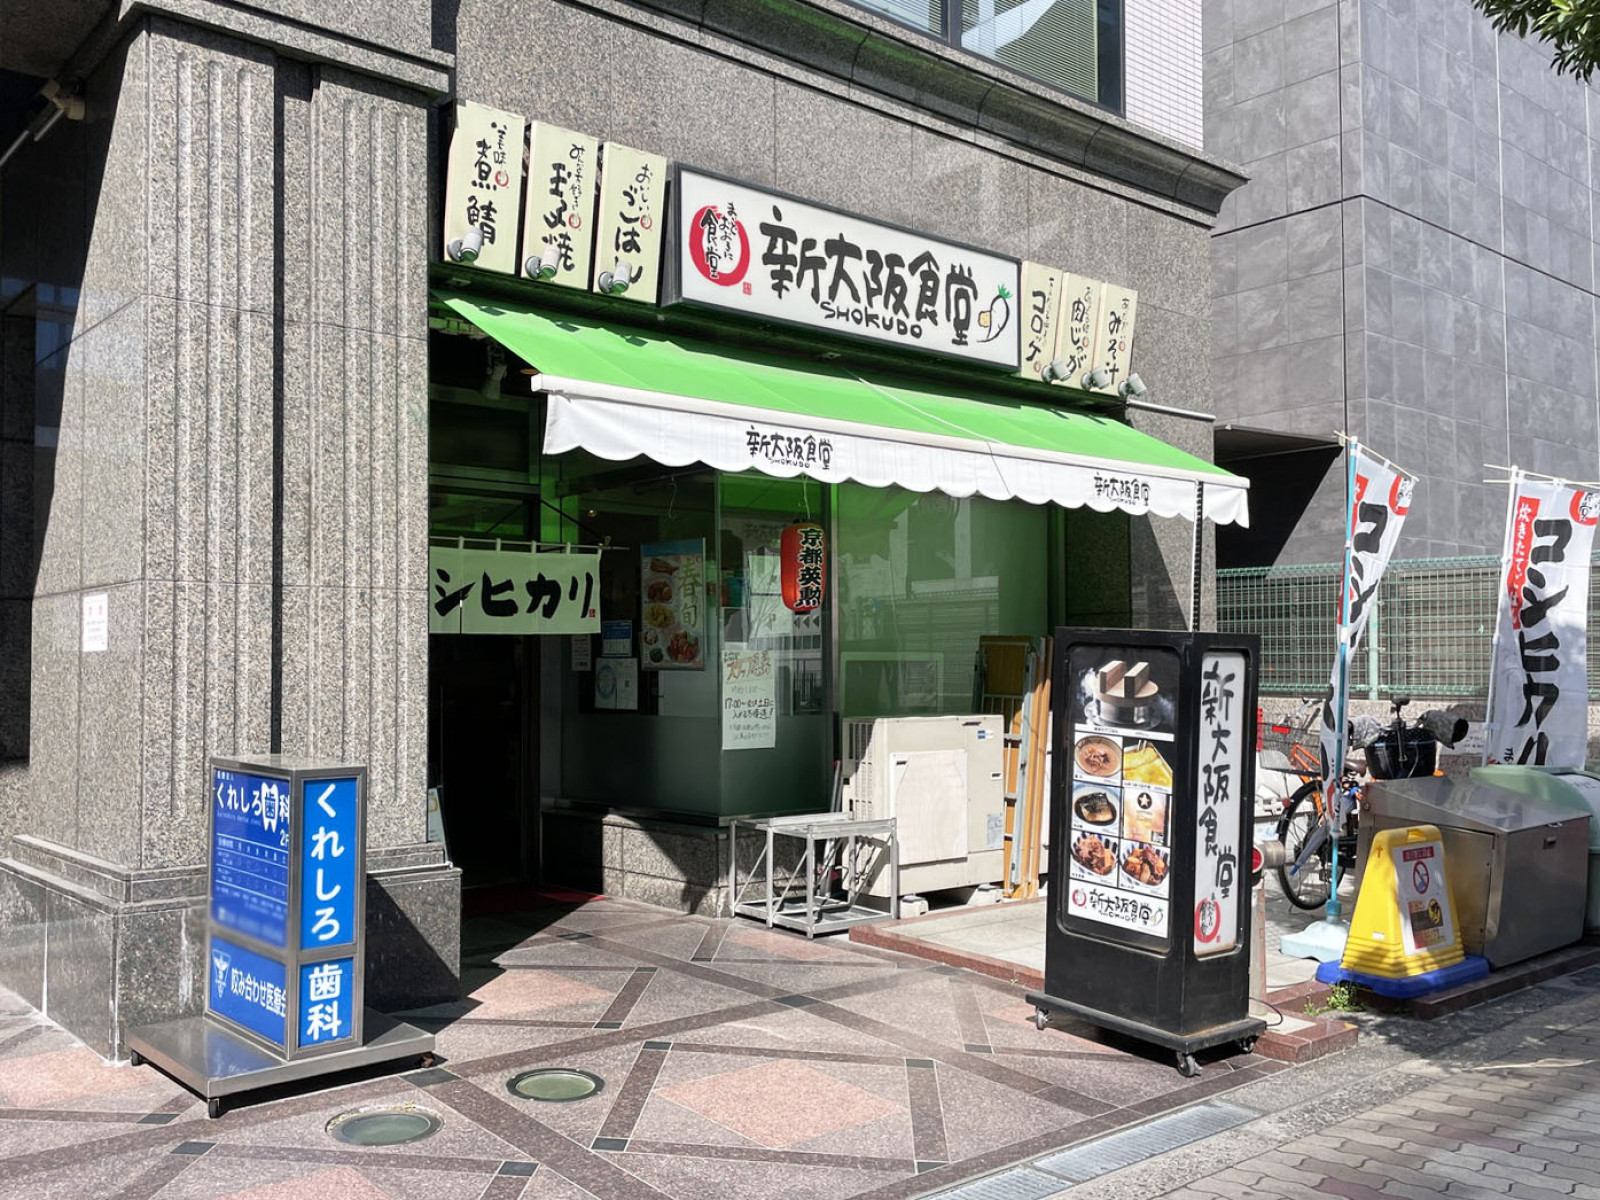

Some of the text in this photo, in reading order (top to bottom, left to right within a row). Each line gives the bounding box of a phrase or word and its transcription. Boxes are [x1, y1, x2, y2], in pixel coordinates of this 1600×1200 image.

[634, 163, 653, 211] おいしい
[700, 208, 722, 279] 食堂
[759, 205, 979, 346] 新大阪食堂
[820, 301, 923, 339] SHOKUDO
[746, 424, 834, 470] 新大阪食堂
[1093, 471, 1151, 507] 新大阪食堂
[1198, 660, 1237, 900] 新大阪食堂
[216, 782, 290, 834] くれしろ歯科
[306, 783, 345, 1041] くれしろ 歯科
[1090, 889, 1153, 926] 新大阪食堂
